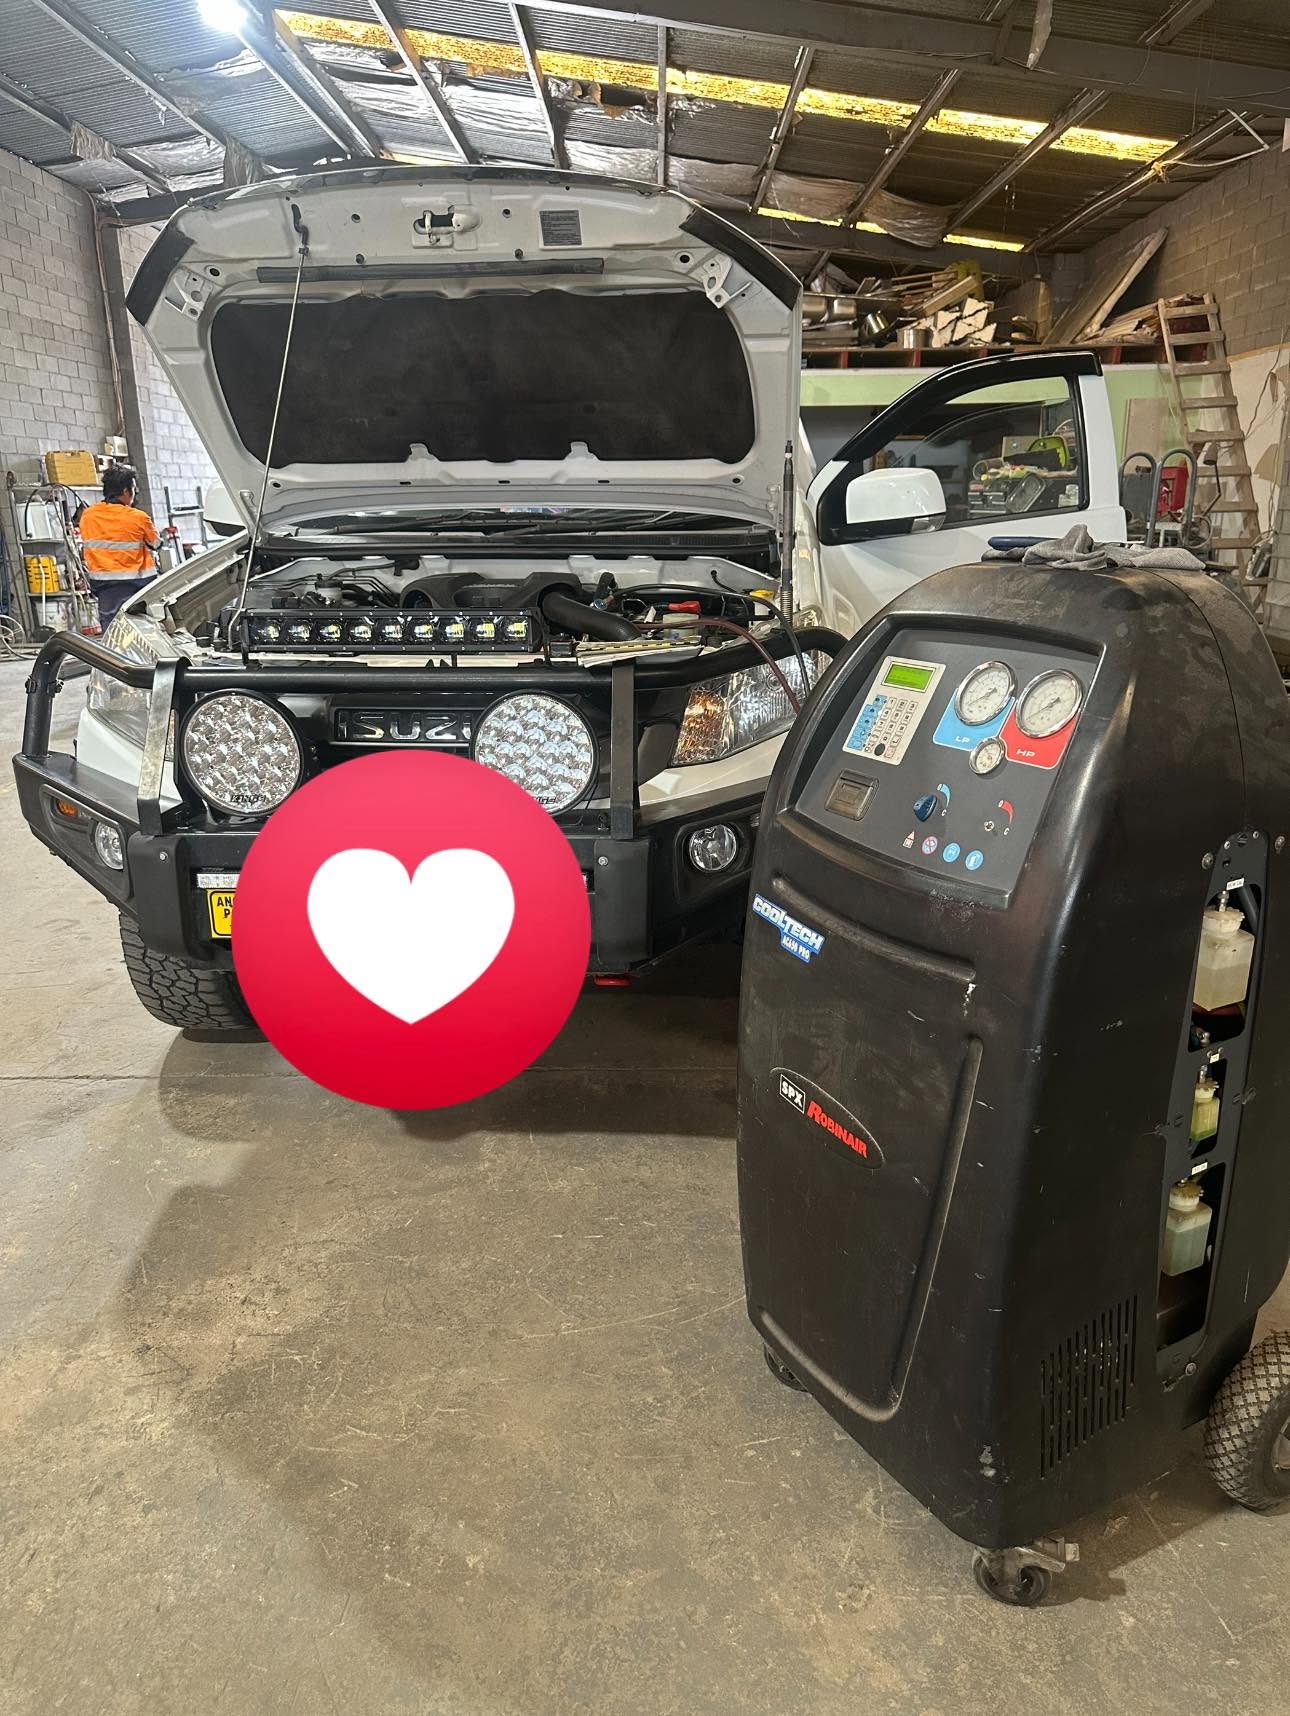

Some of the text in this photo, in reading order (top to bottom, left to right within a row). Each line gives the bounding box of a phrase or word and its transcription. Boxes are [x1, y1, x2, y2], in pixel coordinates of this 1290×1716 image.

[955, 735, 970, 743] LP
[1016, 748, 1036, 757] HP
[216, 896, 235, 908] AN
[223, 908, 231, 918] P
[753, 897, 825, 951] COOLTECH
[781, 1080, 868, 1158] SPX ROBINAIR
